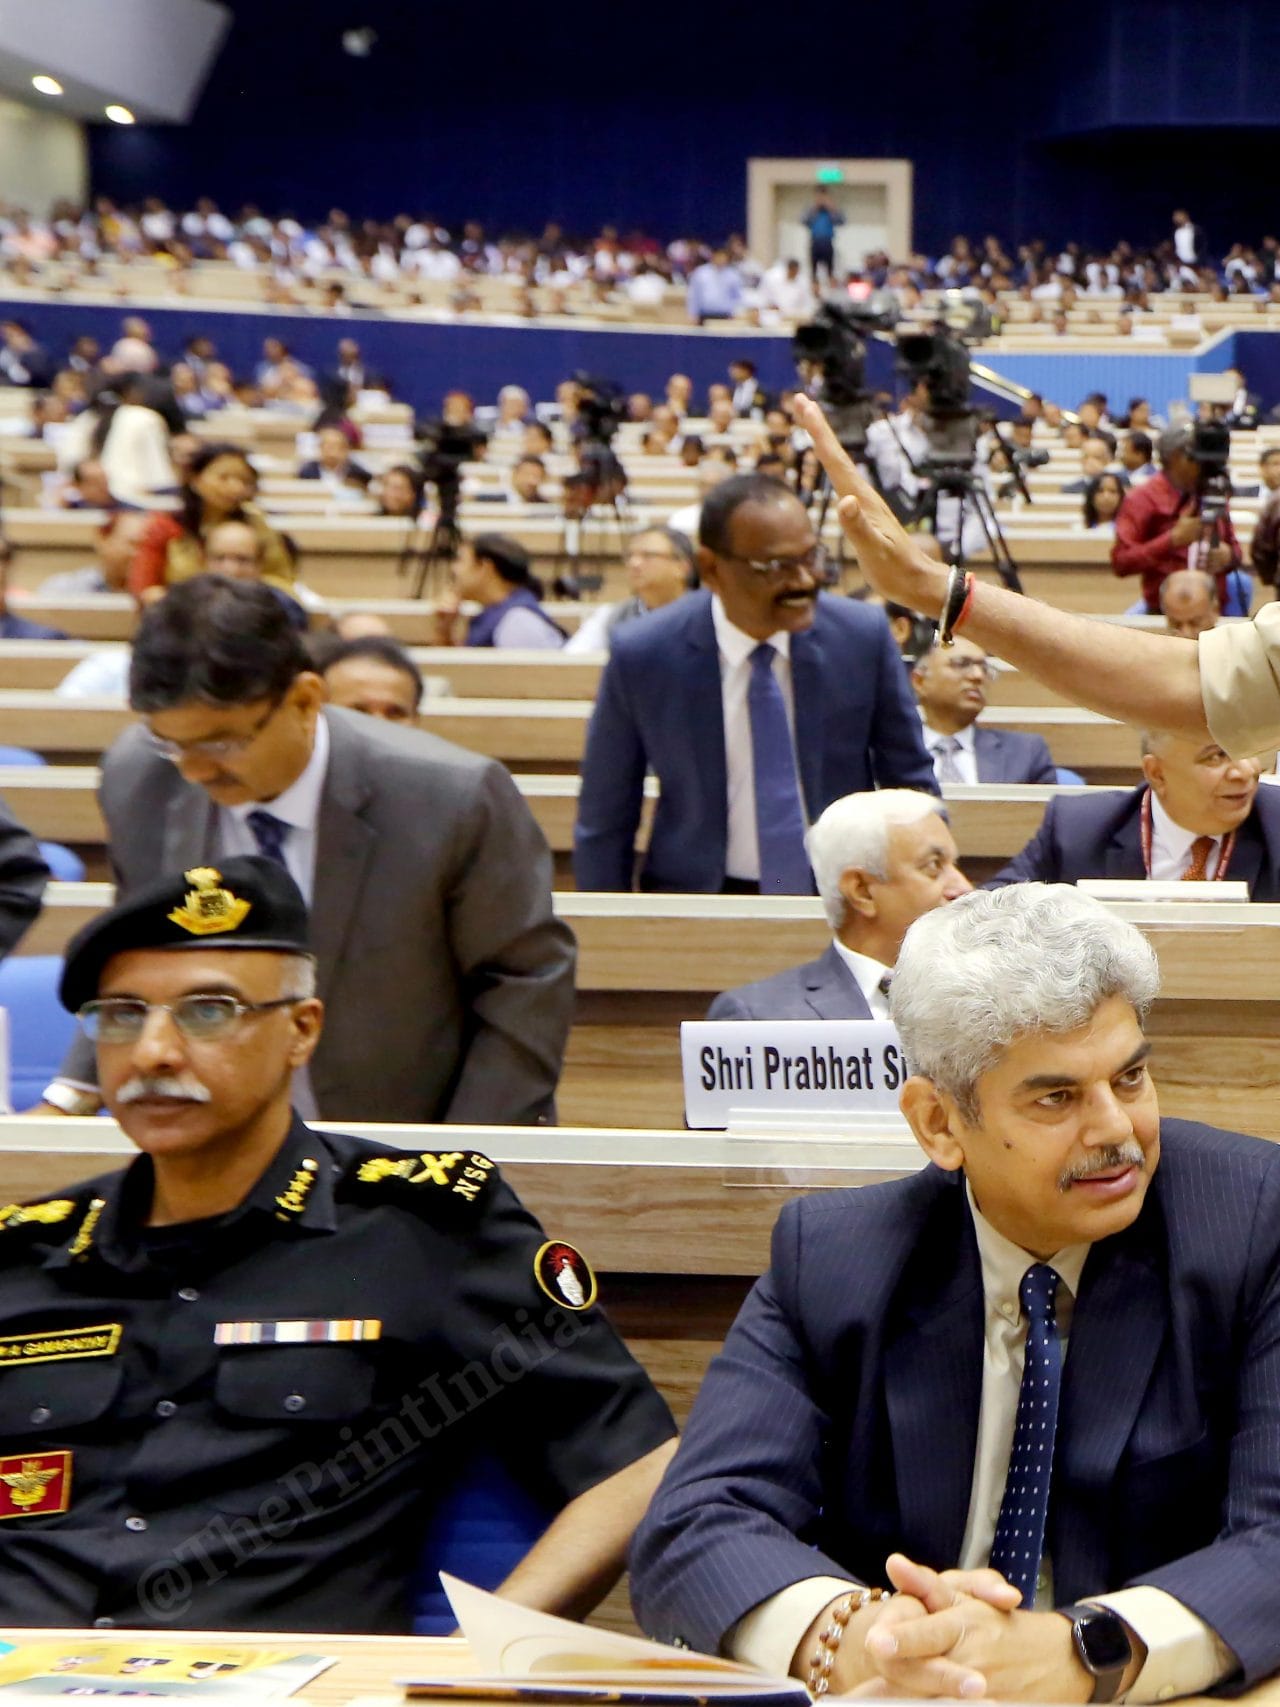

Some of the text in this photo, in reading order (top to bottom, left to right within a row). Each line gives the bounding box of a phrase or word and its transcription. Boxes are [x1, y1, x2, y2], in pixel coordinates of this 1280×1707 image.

[700, 1045, 753, 1091] Shri
[763, 1046, 874, 1090] Prabhat
[452, 1154, 495, 1202] NSG
